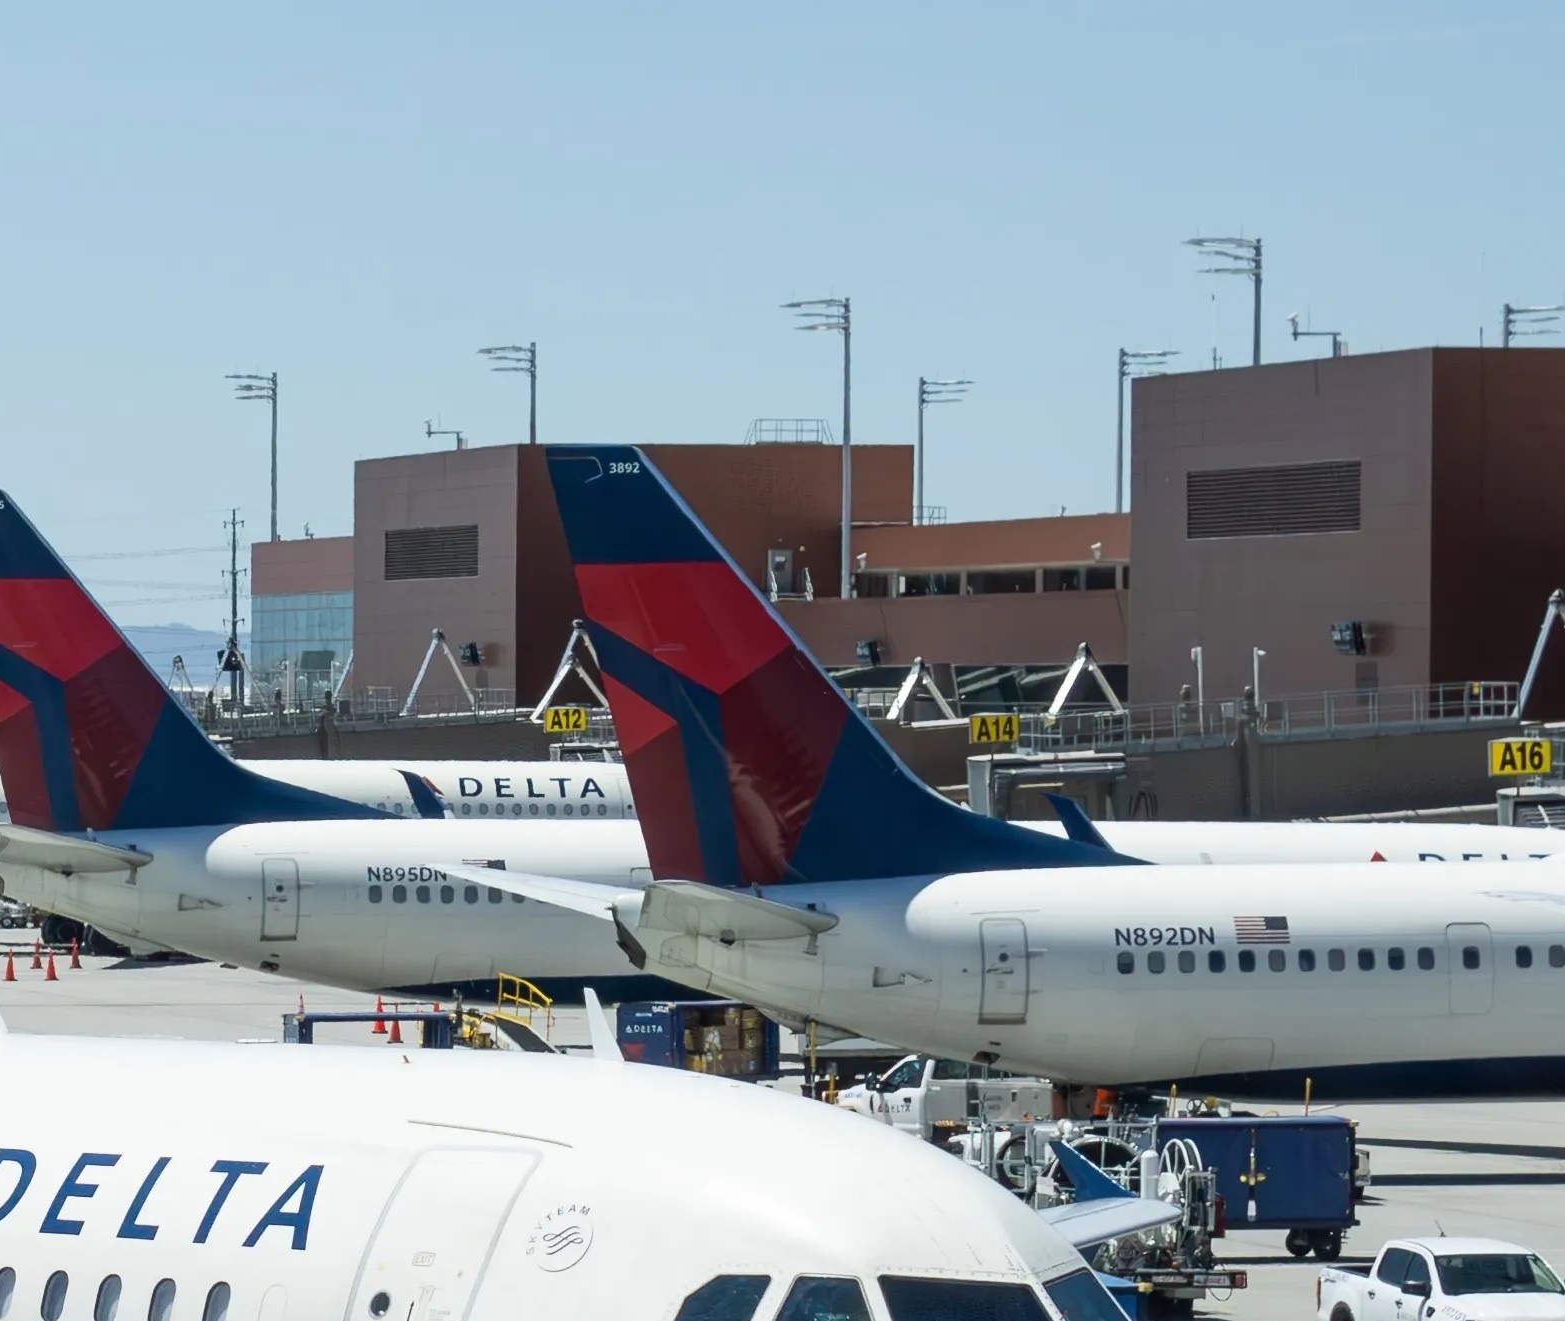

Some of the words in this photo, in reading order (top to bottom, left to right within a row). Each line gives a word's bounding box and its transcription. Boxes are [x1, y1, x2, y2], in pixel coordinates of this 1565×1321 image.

[608, 461, 641, 474] 3892
[550, 709, 582, 730] A12
[976, 716, 1015, 741] A14
[1499, 741, 1544, 771] A16
[458, 777, 606, 799] DELTA
[367, 866, 448, 882] N895DN
[1114, 926, 1216, 946] N892DN
[525, 1204, 591, 1257] SKYTEAM
